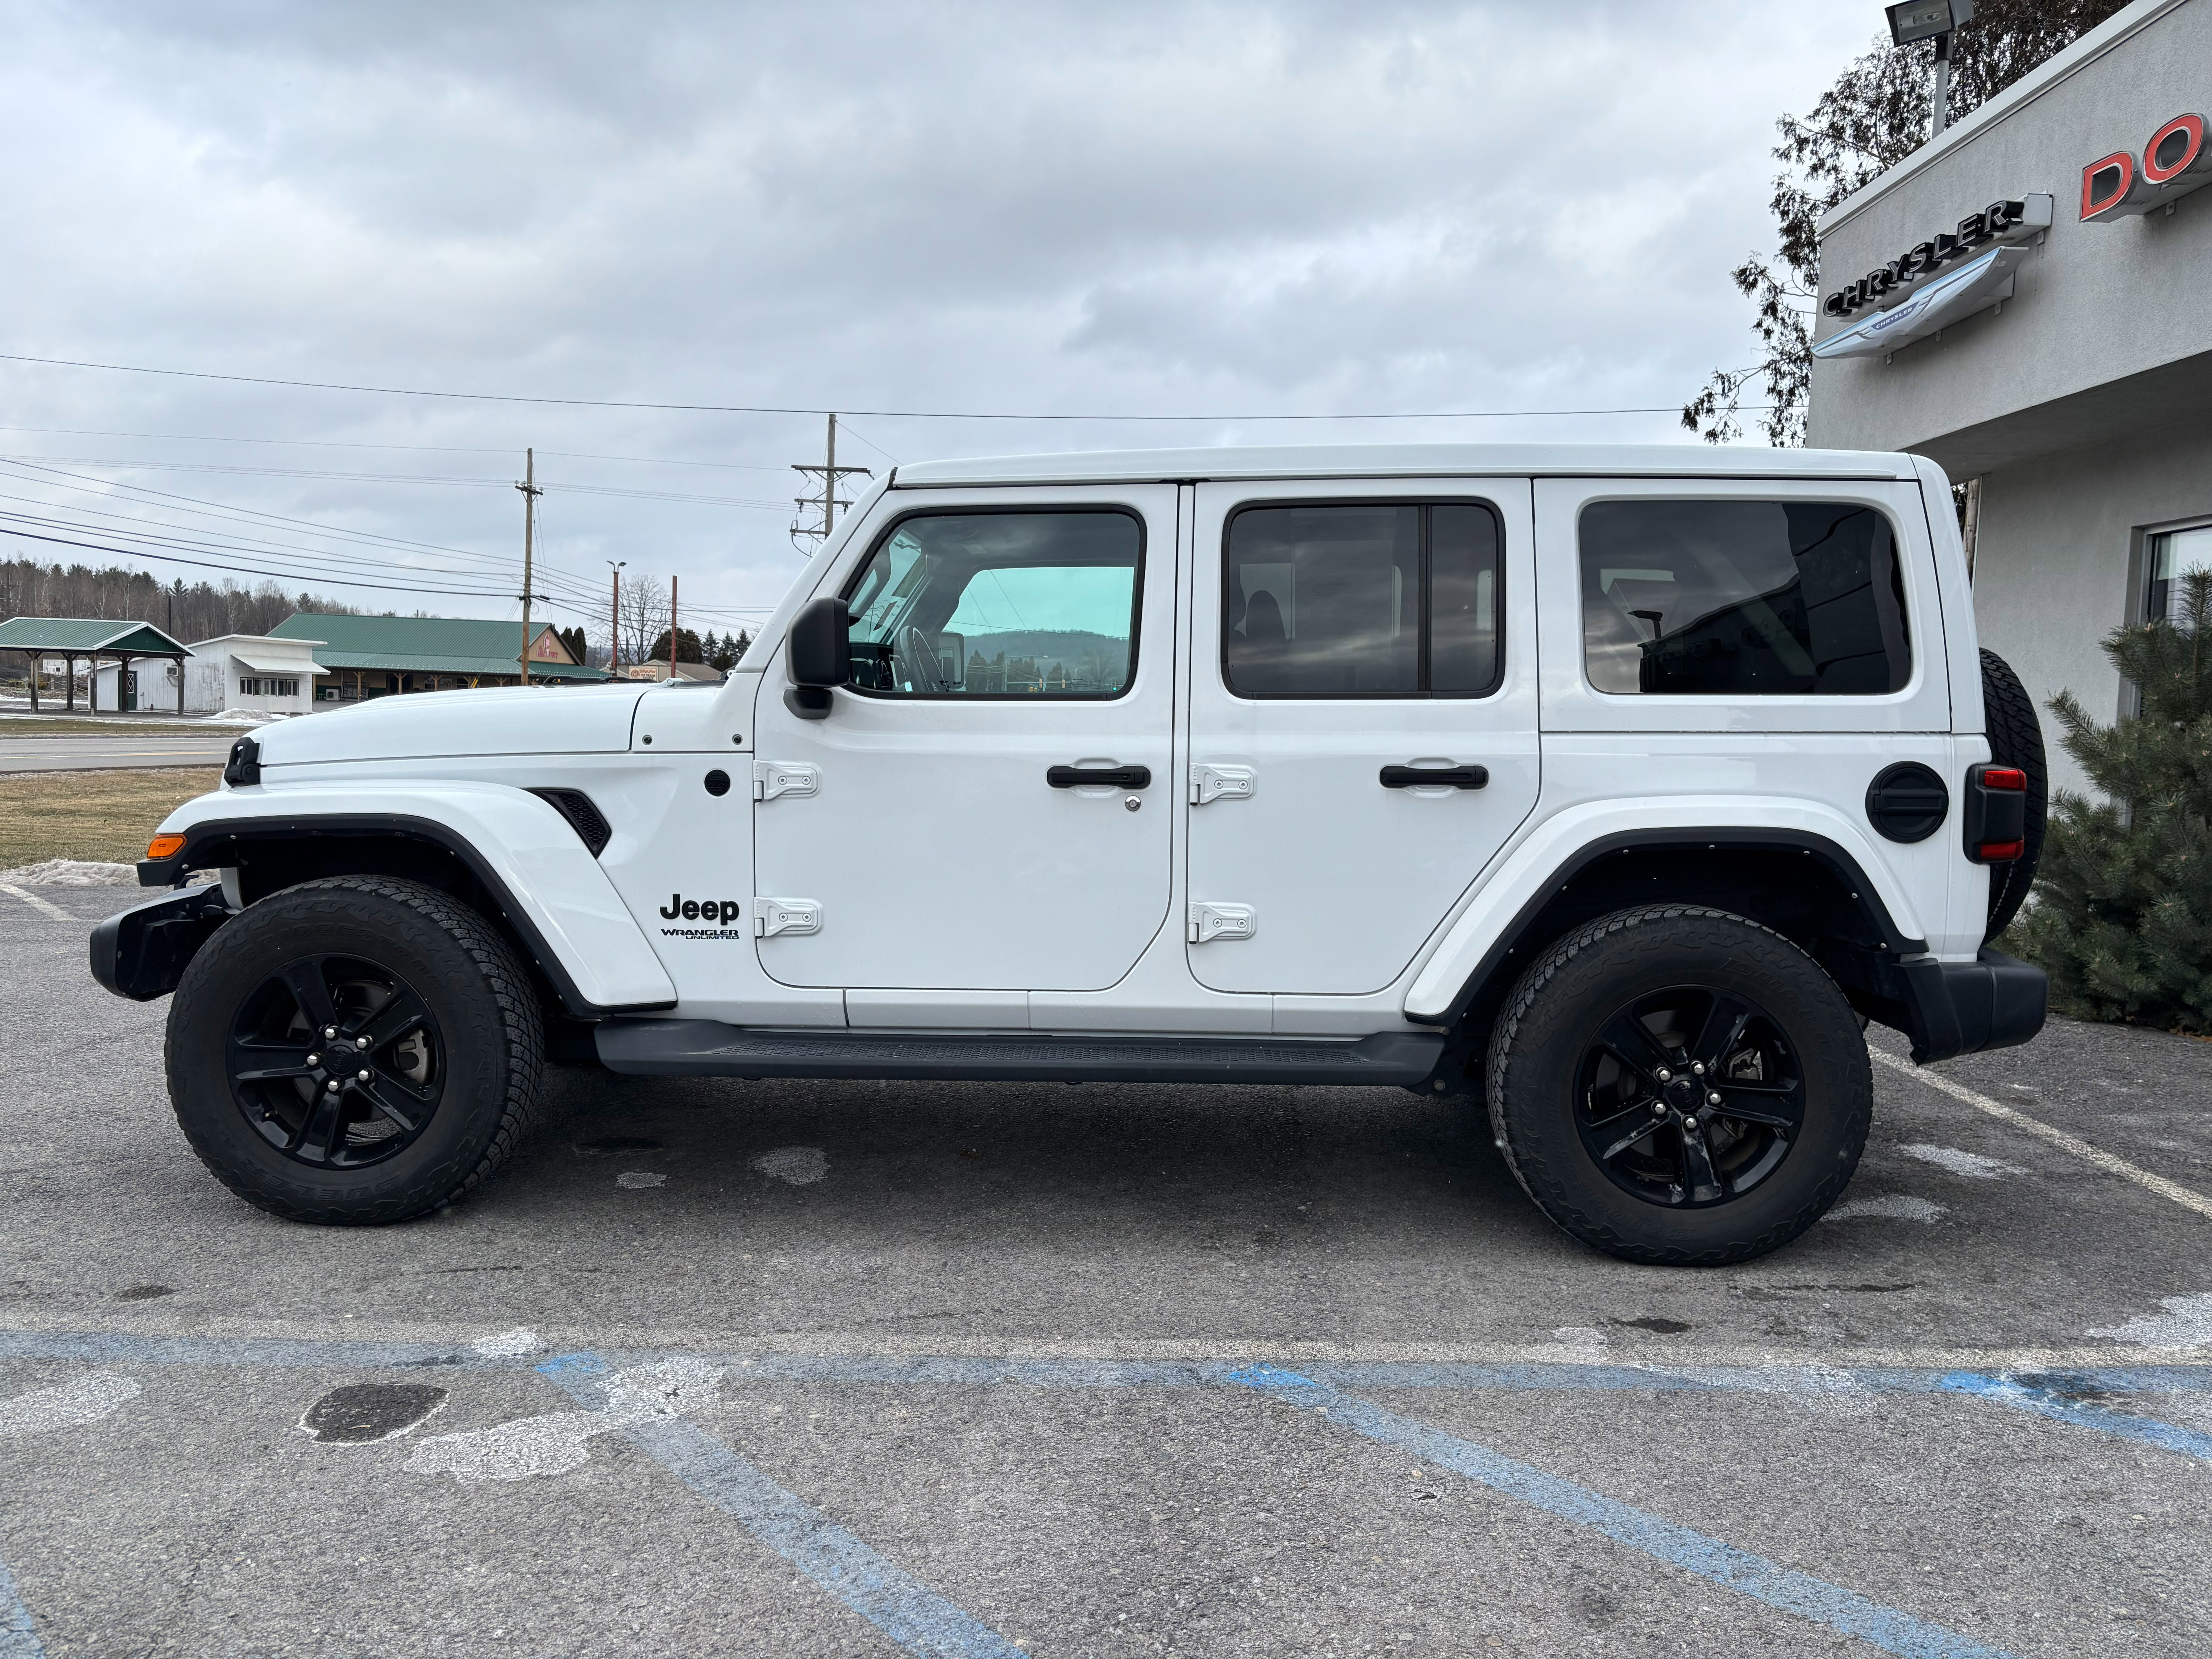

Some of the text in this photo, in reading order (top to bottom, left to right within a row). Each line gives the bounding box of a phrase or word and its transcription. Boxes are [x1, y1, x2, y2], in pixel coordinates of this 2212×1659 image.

[2080, 112, 2207, 222] DO
[1823, 200, 2011, 317] CHRYSLER
[1876, 307, 1912, 328] CHRYSLER
[659, 893, 739, 926] Jeep
[235, 921, 445, 989] BRIDGESTONE
[239, 1158, 402, 1201] DUELER
[1544, 1080, 1695, 1241] BRIDGESTONE
